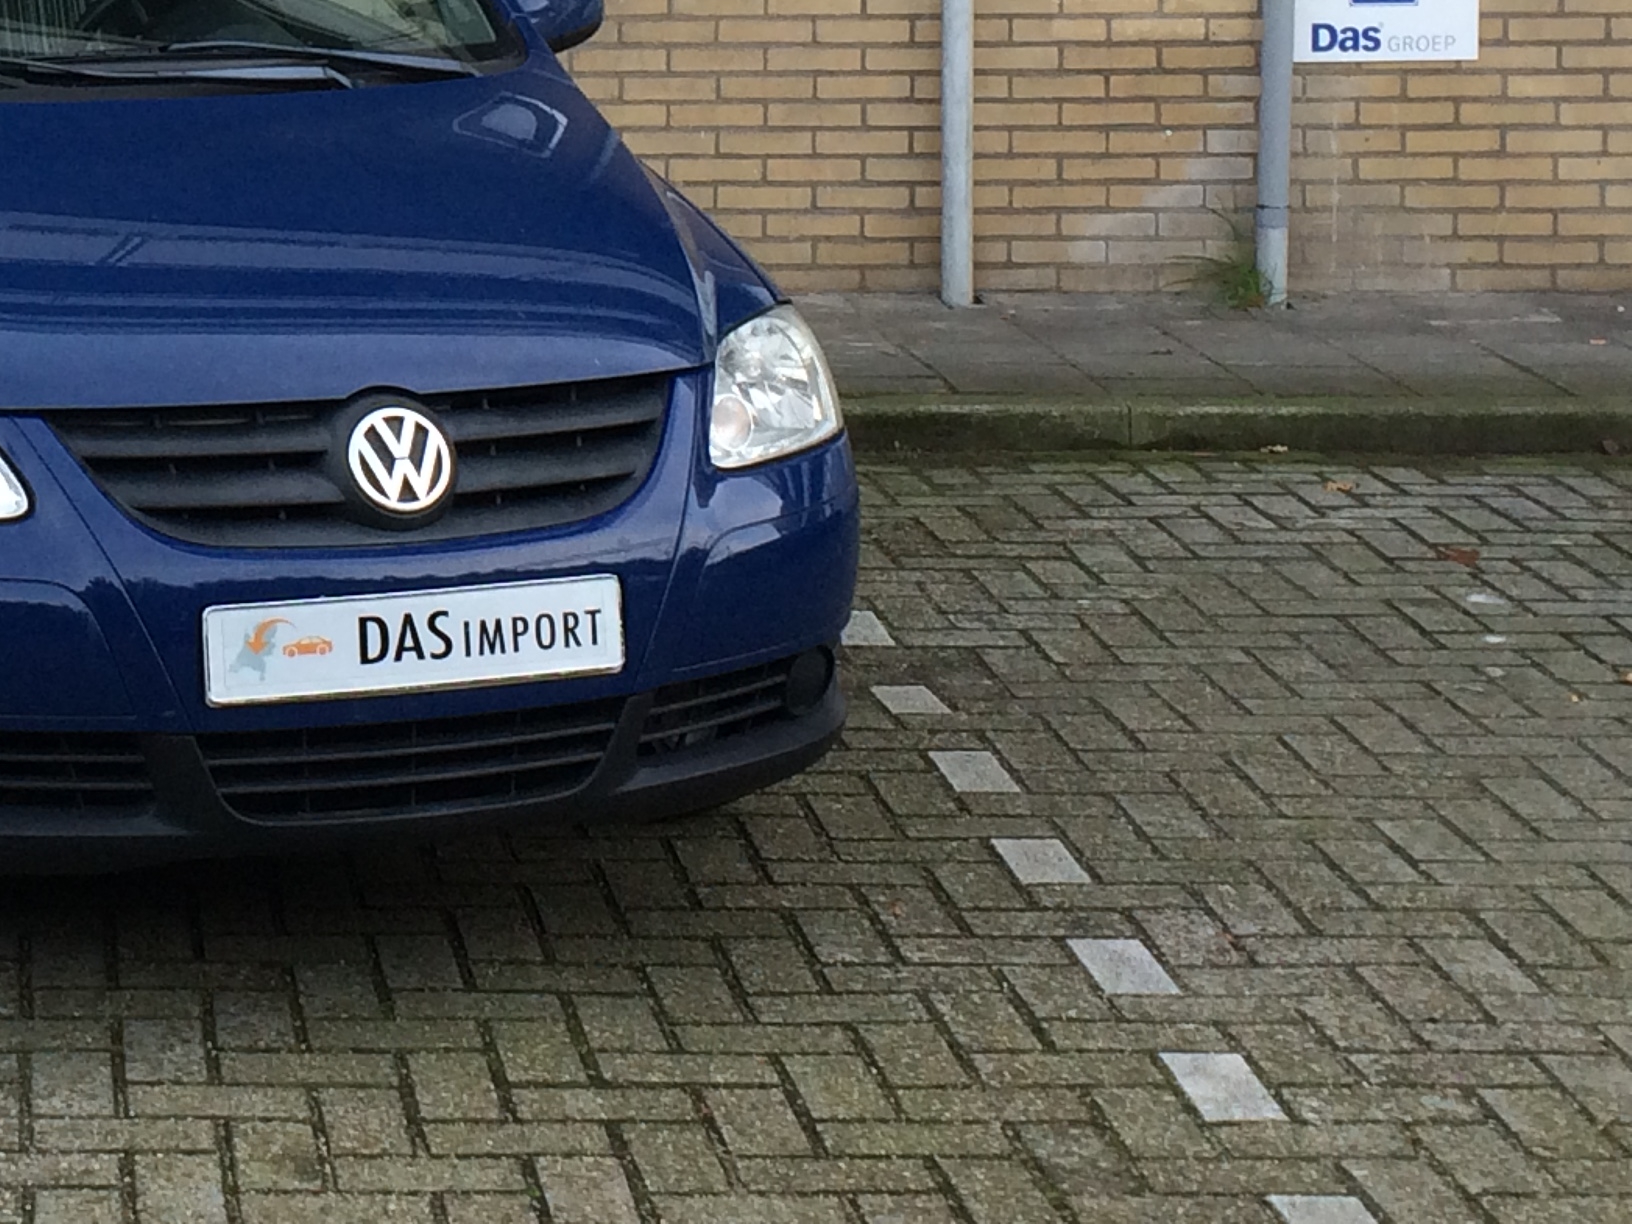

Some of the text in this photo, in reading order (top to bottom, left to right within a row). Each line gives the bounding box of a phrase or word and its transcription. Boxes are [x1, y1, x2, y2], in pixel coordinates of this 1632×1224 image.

[1311, 23, 1456, 53] Das GROEP
[357, 608, 603, 665] DAS IMPORT
